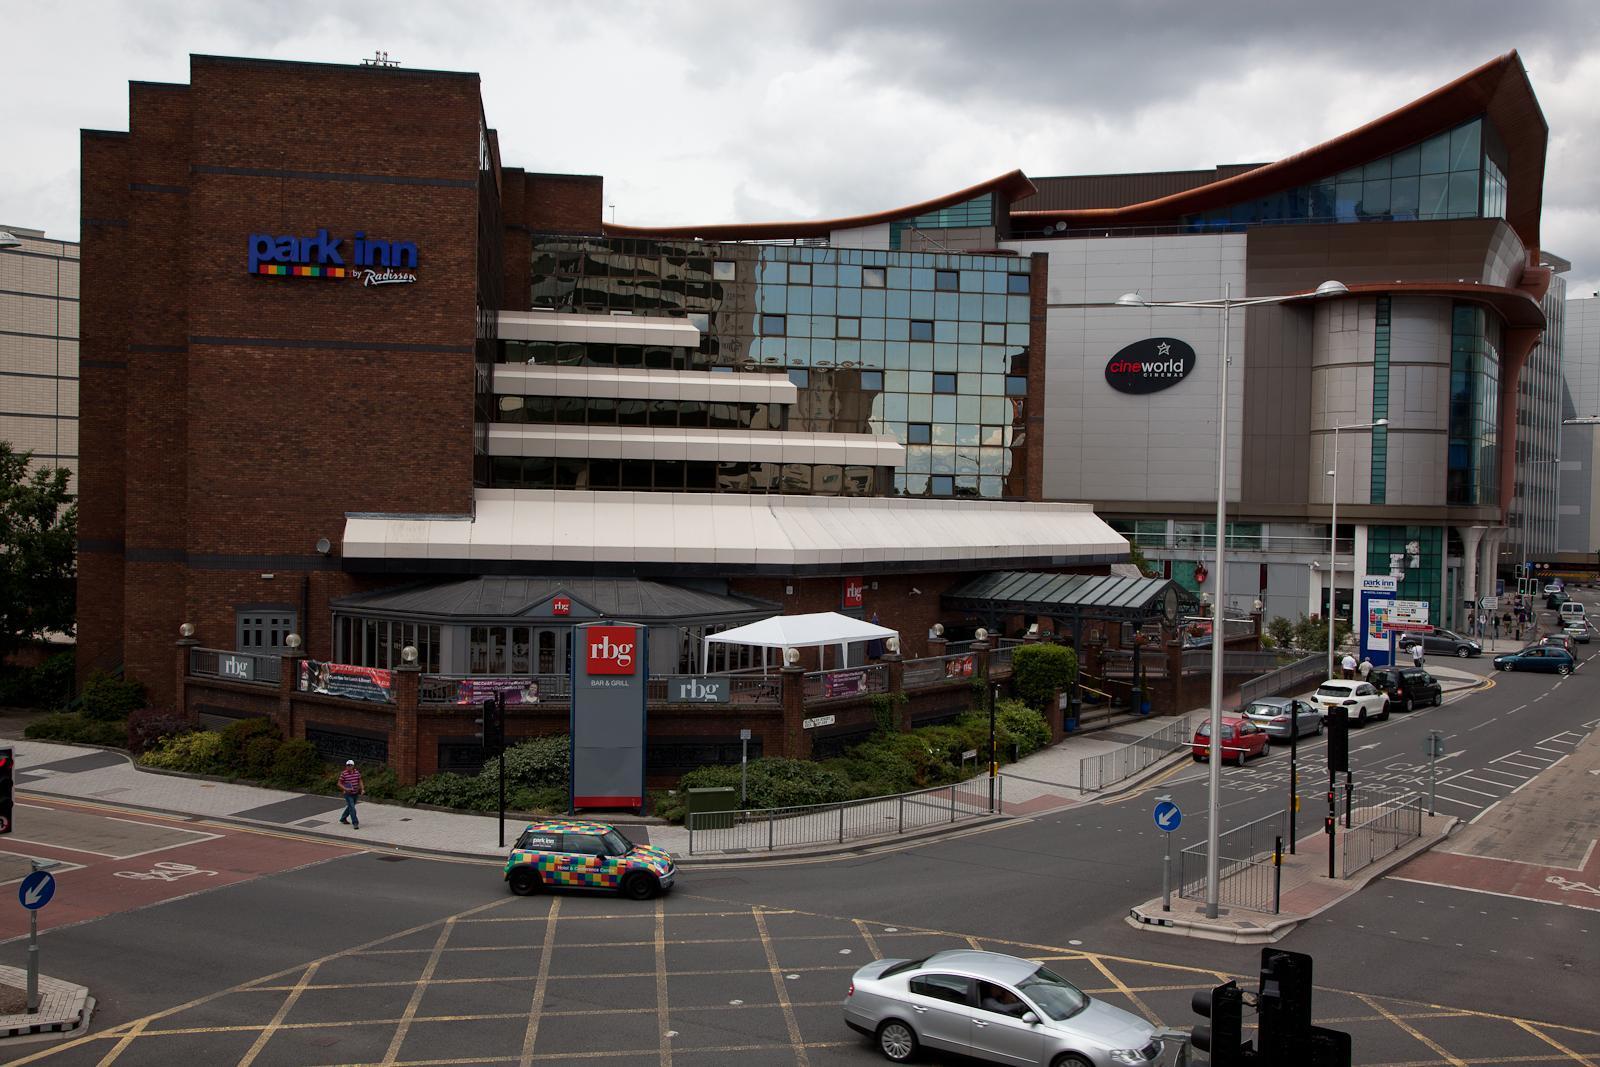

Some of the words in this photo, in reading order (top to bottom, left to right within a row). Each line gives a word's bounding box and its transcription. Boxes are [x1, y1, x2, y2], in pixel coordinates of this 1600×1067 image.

[248, 229, 345, 274] park
[354, 231, 417, 268] inn
[352, 269, 362, 279] by
[364, 268, 417, 287] Radisson
[1110, 359, 1184, 373] cineworld
[847, 582, 862, 601] rbg
[1364, 579, 1381, 587] park
[554, 601, 569, 612] rbg
[590, 636, 634, 667] rbg
[224, 656, 248, 679] rbg
[680, 679, 719, 702] rbg
